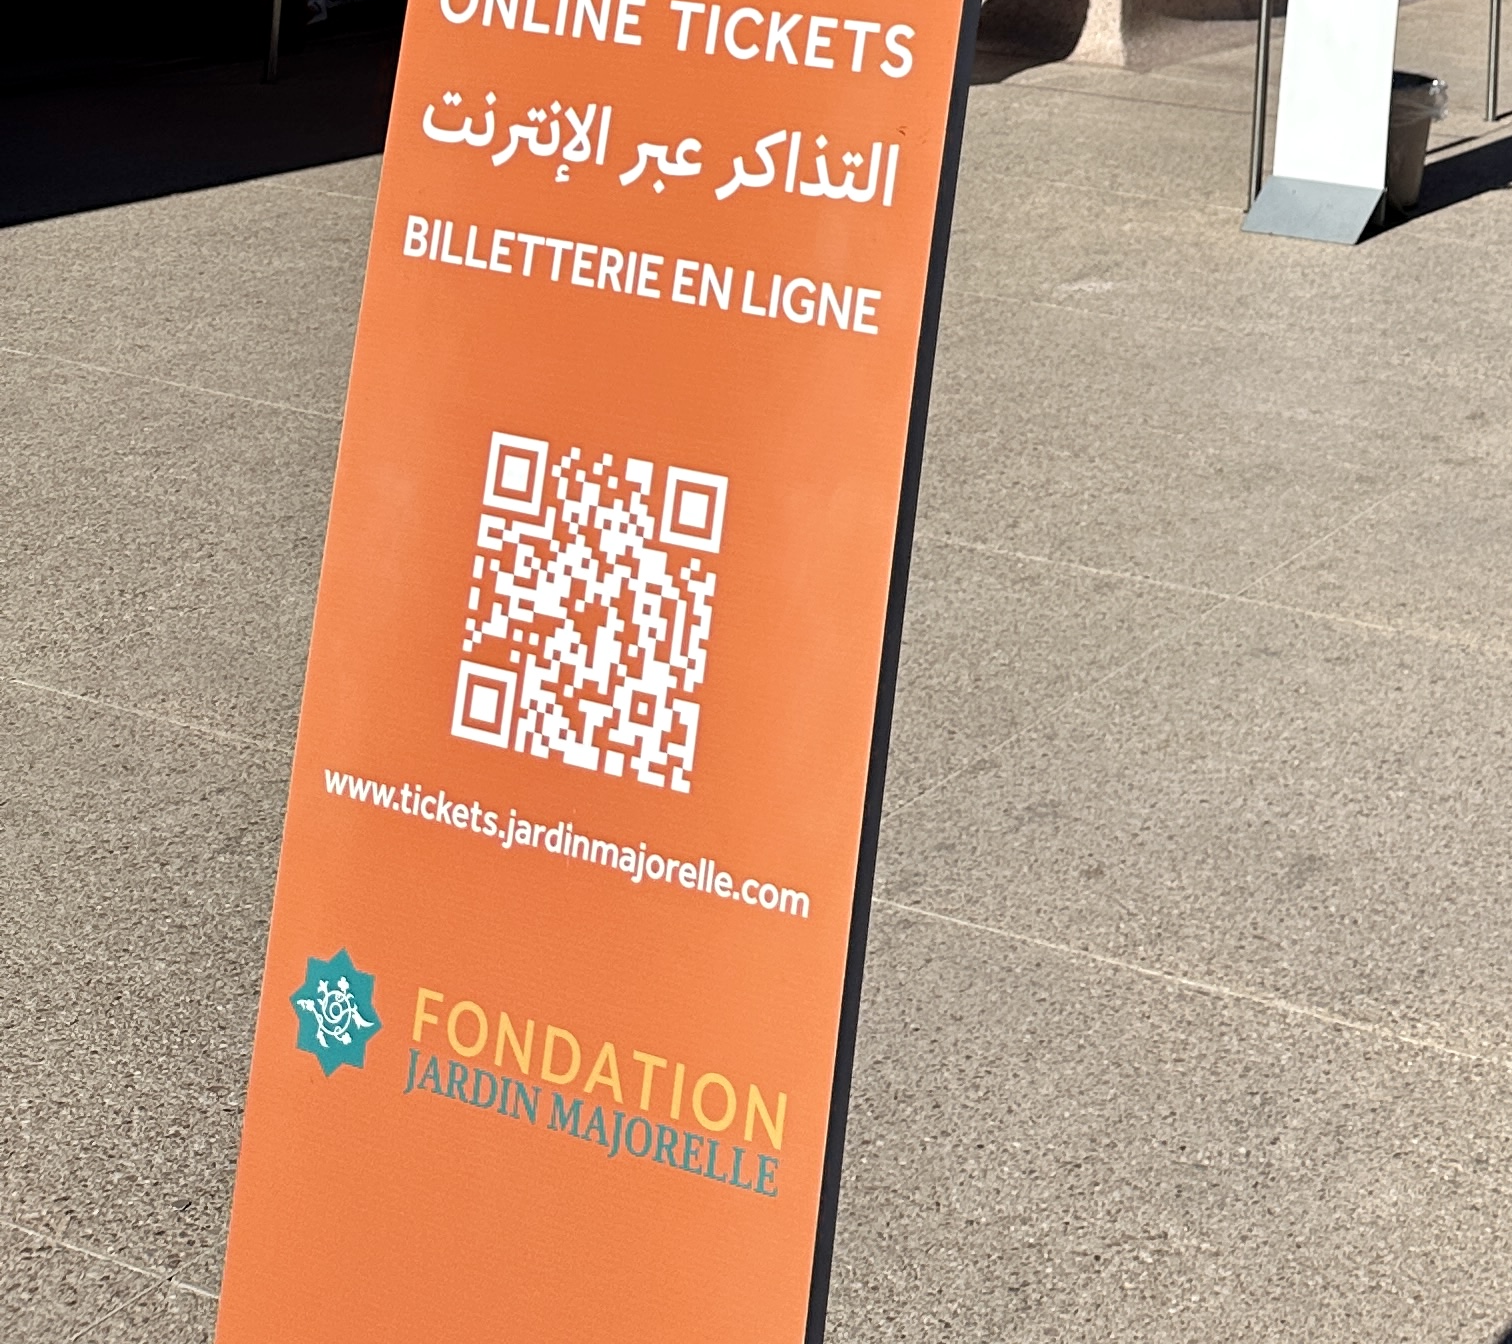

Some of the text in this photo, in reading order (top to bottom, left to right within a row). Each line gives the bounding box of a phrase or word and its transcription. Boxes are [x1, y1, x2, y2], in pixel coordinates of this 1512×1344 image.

[670, 0, 917, 78] TICKETS
[422, 91, 900, 207] التذاكر عبر الإنترنت
[403, 215, 882, 335] BILLETTERIE EN LIGNE
[324, 769, 810, 918] www.tickets.jardinmajorelle.com
[403, 1048, 779, 1197] JARDIN MAJORELLE
[413, 987, 787, 1150] FONDATION
